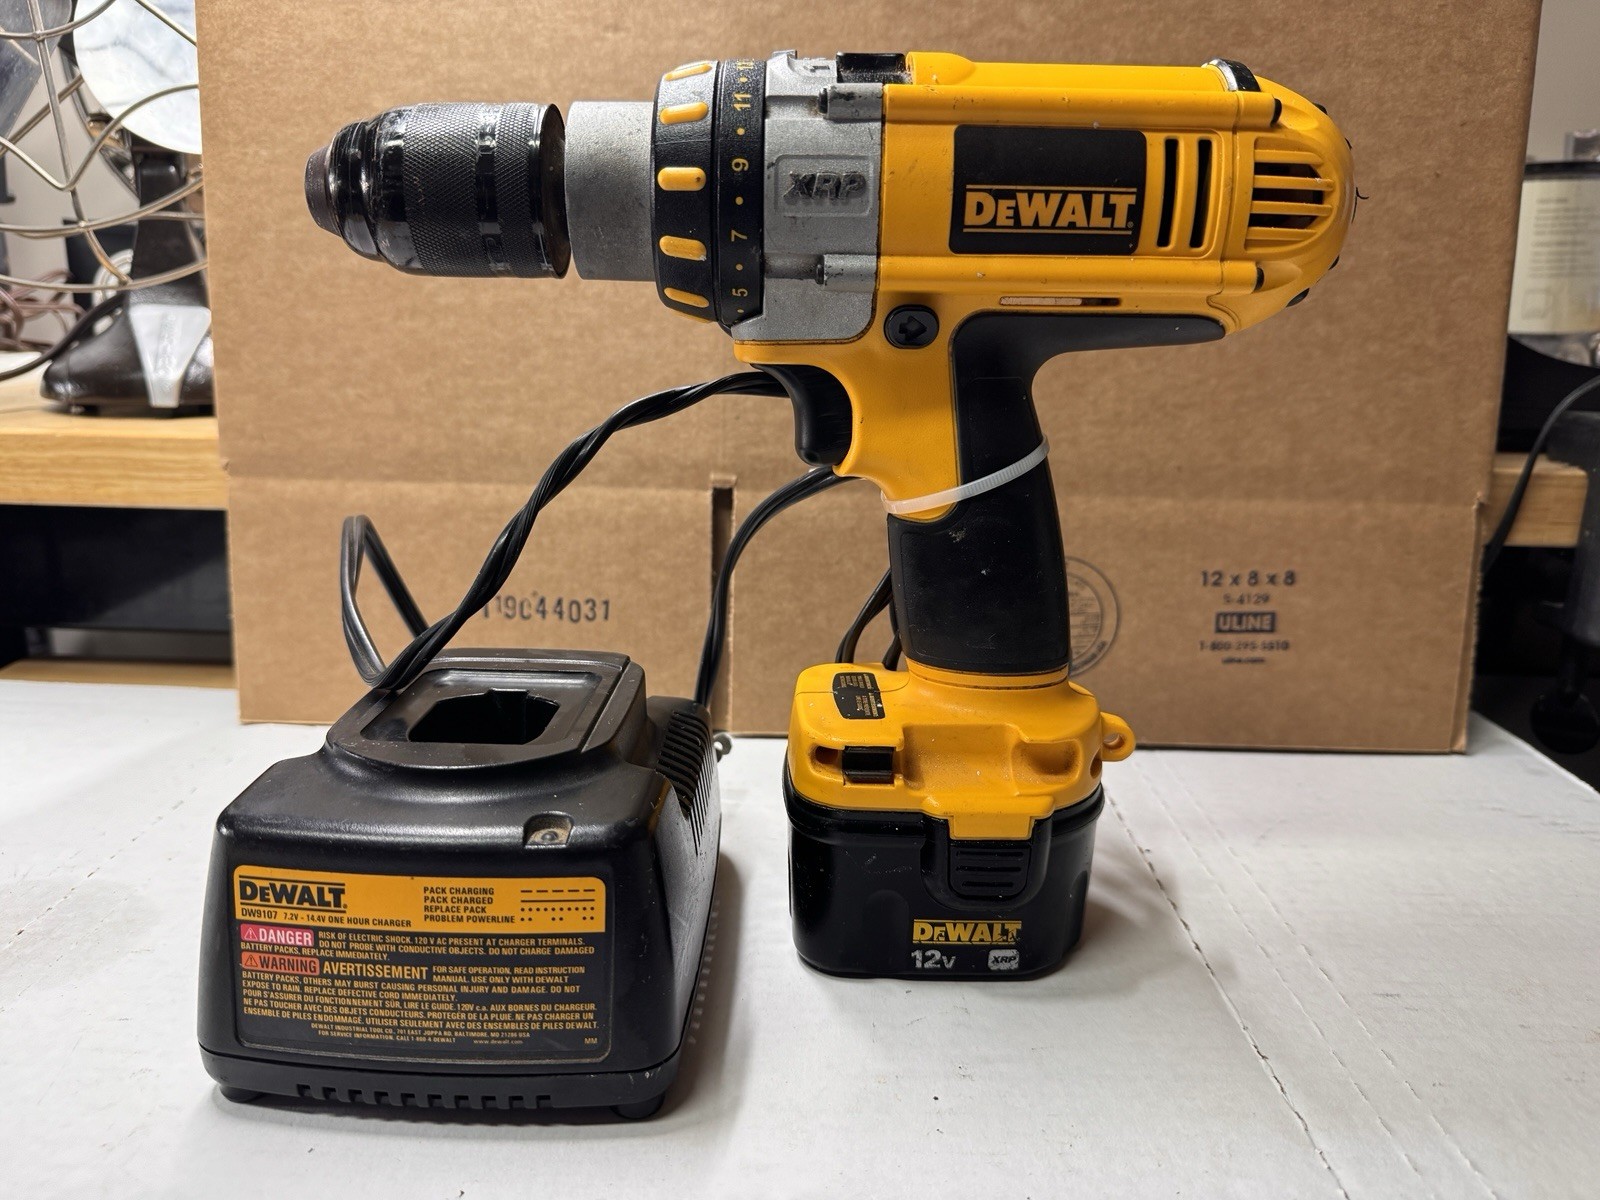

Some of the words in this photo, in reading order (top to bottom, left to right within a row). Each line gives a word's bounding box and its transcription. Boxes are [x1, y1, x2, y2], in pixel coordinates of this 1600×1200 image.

[733, 92, 752, 111] 11
[731, 158, 749, 171] 9
[782, 170, 868, 200] XRP
[963, 191, 1137, 229] DEWALT
[731, 229, 748, 242] 7
[732, 287, 748, 298] 5
[1201, 570, 1223, 587] 12
[1229, 573, 1240, 586] x
[1247, 570, 1259, 587] 8
[1266, 573, 1277, 586] x
[1283, 570, 1296, 587] 8
[1219, 614, 1272, 630] ULINE
[239, 879, 346, 909] DEWALT
[424, 886, 447, 895] PACK
[449, 887, 495, 895] CHARGING
[424, 895, 448, 904] PACK
[450, 896, 494, 905] CHARGED
[241, 907, 278, 920] DW9107
[283, 912, 299, 921] 7.2V
[306, 914, 326, 923] 14.4V
[328, 915, 345, 924] ONE
[347, 916, 370, 926] HOUR
[372, 917, 412, 928] CHARGER
[424, 905, 461, 914] REPLACE
[463, 905, 487, 914] PACK
[424, 914, 464, 923] PROBLEM
[466, 915, 515, 924] POWERLINE
[259, 927, 313, 946] DANGER
[318, 930, 336, 940] RISK
[337, 932, 347, 940] OF
[348, 933, 384, 943] ELECTRIC
[415, 936, 428, 945] 120
[429, 937, 435, 945] V
[436, 937, 447, 945] AC
[448, 937, 483, 946] PRESENT
[486, 938, 497, 946] AT
[498, 938, 536, 946] CHARGER
[537, 937, 585, 946] TERMINALS.
[912, 922, 1022, 942] DEWALT
[240, 941, 274, 952] BATTERY
[302, 947, 335, 957] REPLACE
[335, 949, 390, 961] IMMEDIATELY.
[319, 940, 330, 949] DO
[331, 941, 347, 949] NOT
[349, 942, 375, 951] PROBE
[376, 943, 396, 952] WITH
[398, 945, 447, 954] CONDUCTIVE
[448, 946, 486, 955] OBJECTS.
[488, 947, 500, 955] DO
[501, 947, 519, 955] NOT
[520, 947, 551, 955] CHARGE
[554, 946, 595, 955] DAMAGED
[259, 955, 317, 973] WARNING
[991, 955, 1017, 964] XRP
[323, 961, 428, 980] AVERTISSEMENT
[432, 965, 447, 973] FOR
[448, 966, 467, 974] SAFE
[513, 966, 534, 975] READ
[534, 966, 586, 974] INSTRUCTION
[242, 970, 274, 981] BATTERY
[303, 976, 332, 986] OTHERS
[334, 979, 352, 988] MAY
[353, 980, 380, 989] BURST
[381, 982, 415, 991] CAUSING
[417, 983, 458, 993] PERSONAL
[460, 985, 489, 993] INJURY
[491, 985, 509, 994] AND
[511, 985, 549, 994] DAMAGE.
[550, 985, 562, 993] DO
[564, 985, 581, 993] NOT
[471, 975, 488, 983] USE
[489, 976, 510, 984] ONLY
[535, 975, 569, 983] DEWALT
[242, 980, 270, 989] EXPOSE
[271, 982, 281, 990] TO
[304, 986, 336, 995] REPLACE
[337, 988, 378, 998] DEFECTIVE
[379, 991, 400, 999] CORD
[401, 992, 457, 1001] IMMEDIATELY.
[243, 989, 262, 998] POUR
[263, 991, 303, 1001] S'ASSURER
[303, 995, 314, 1003] DU
[315, 995, 383, 1007] FONCTIONNEMENT
[403, 1001, 419, 1009] LIRE
[420, 1002, 429, 1010] LE
[490, 1004, 507, 1012] AUX
[554, 1003, 597, 1011] CHARGEUR.
[243, 997, 252, 1006] NE
[253, 999, 268, 1007] PAS
[270, 1001, 302, 1011] TOUCHER
[303, 1004, 322, 1012] AVEC
[323, 1005, 338, 1013] DES
[339, 1007, 368, 1016] OBJETS
[467, 1012, 478, 1020] DE
[544, 1012, 580, 1020] CHARGER
[582, 1012, 594, 1020] UN
[243, 1007, 281, 1018] ENSEMBLE
[281, 1010, 291, 1018] DE
[292, 1012, 312, 1020] PILES
[365, 1017, 398, 1026] UTILISER
[399, 1019, 444, 1028] SEULEMENT
[445, 1021, 466, 1029] AVEC
[466, 1021, 482, 1029] DES
[483, 1021, 530, 1030] ENSEMBLES
[565, 1021, 600, 1029] DEWALT.
